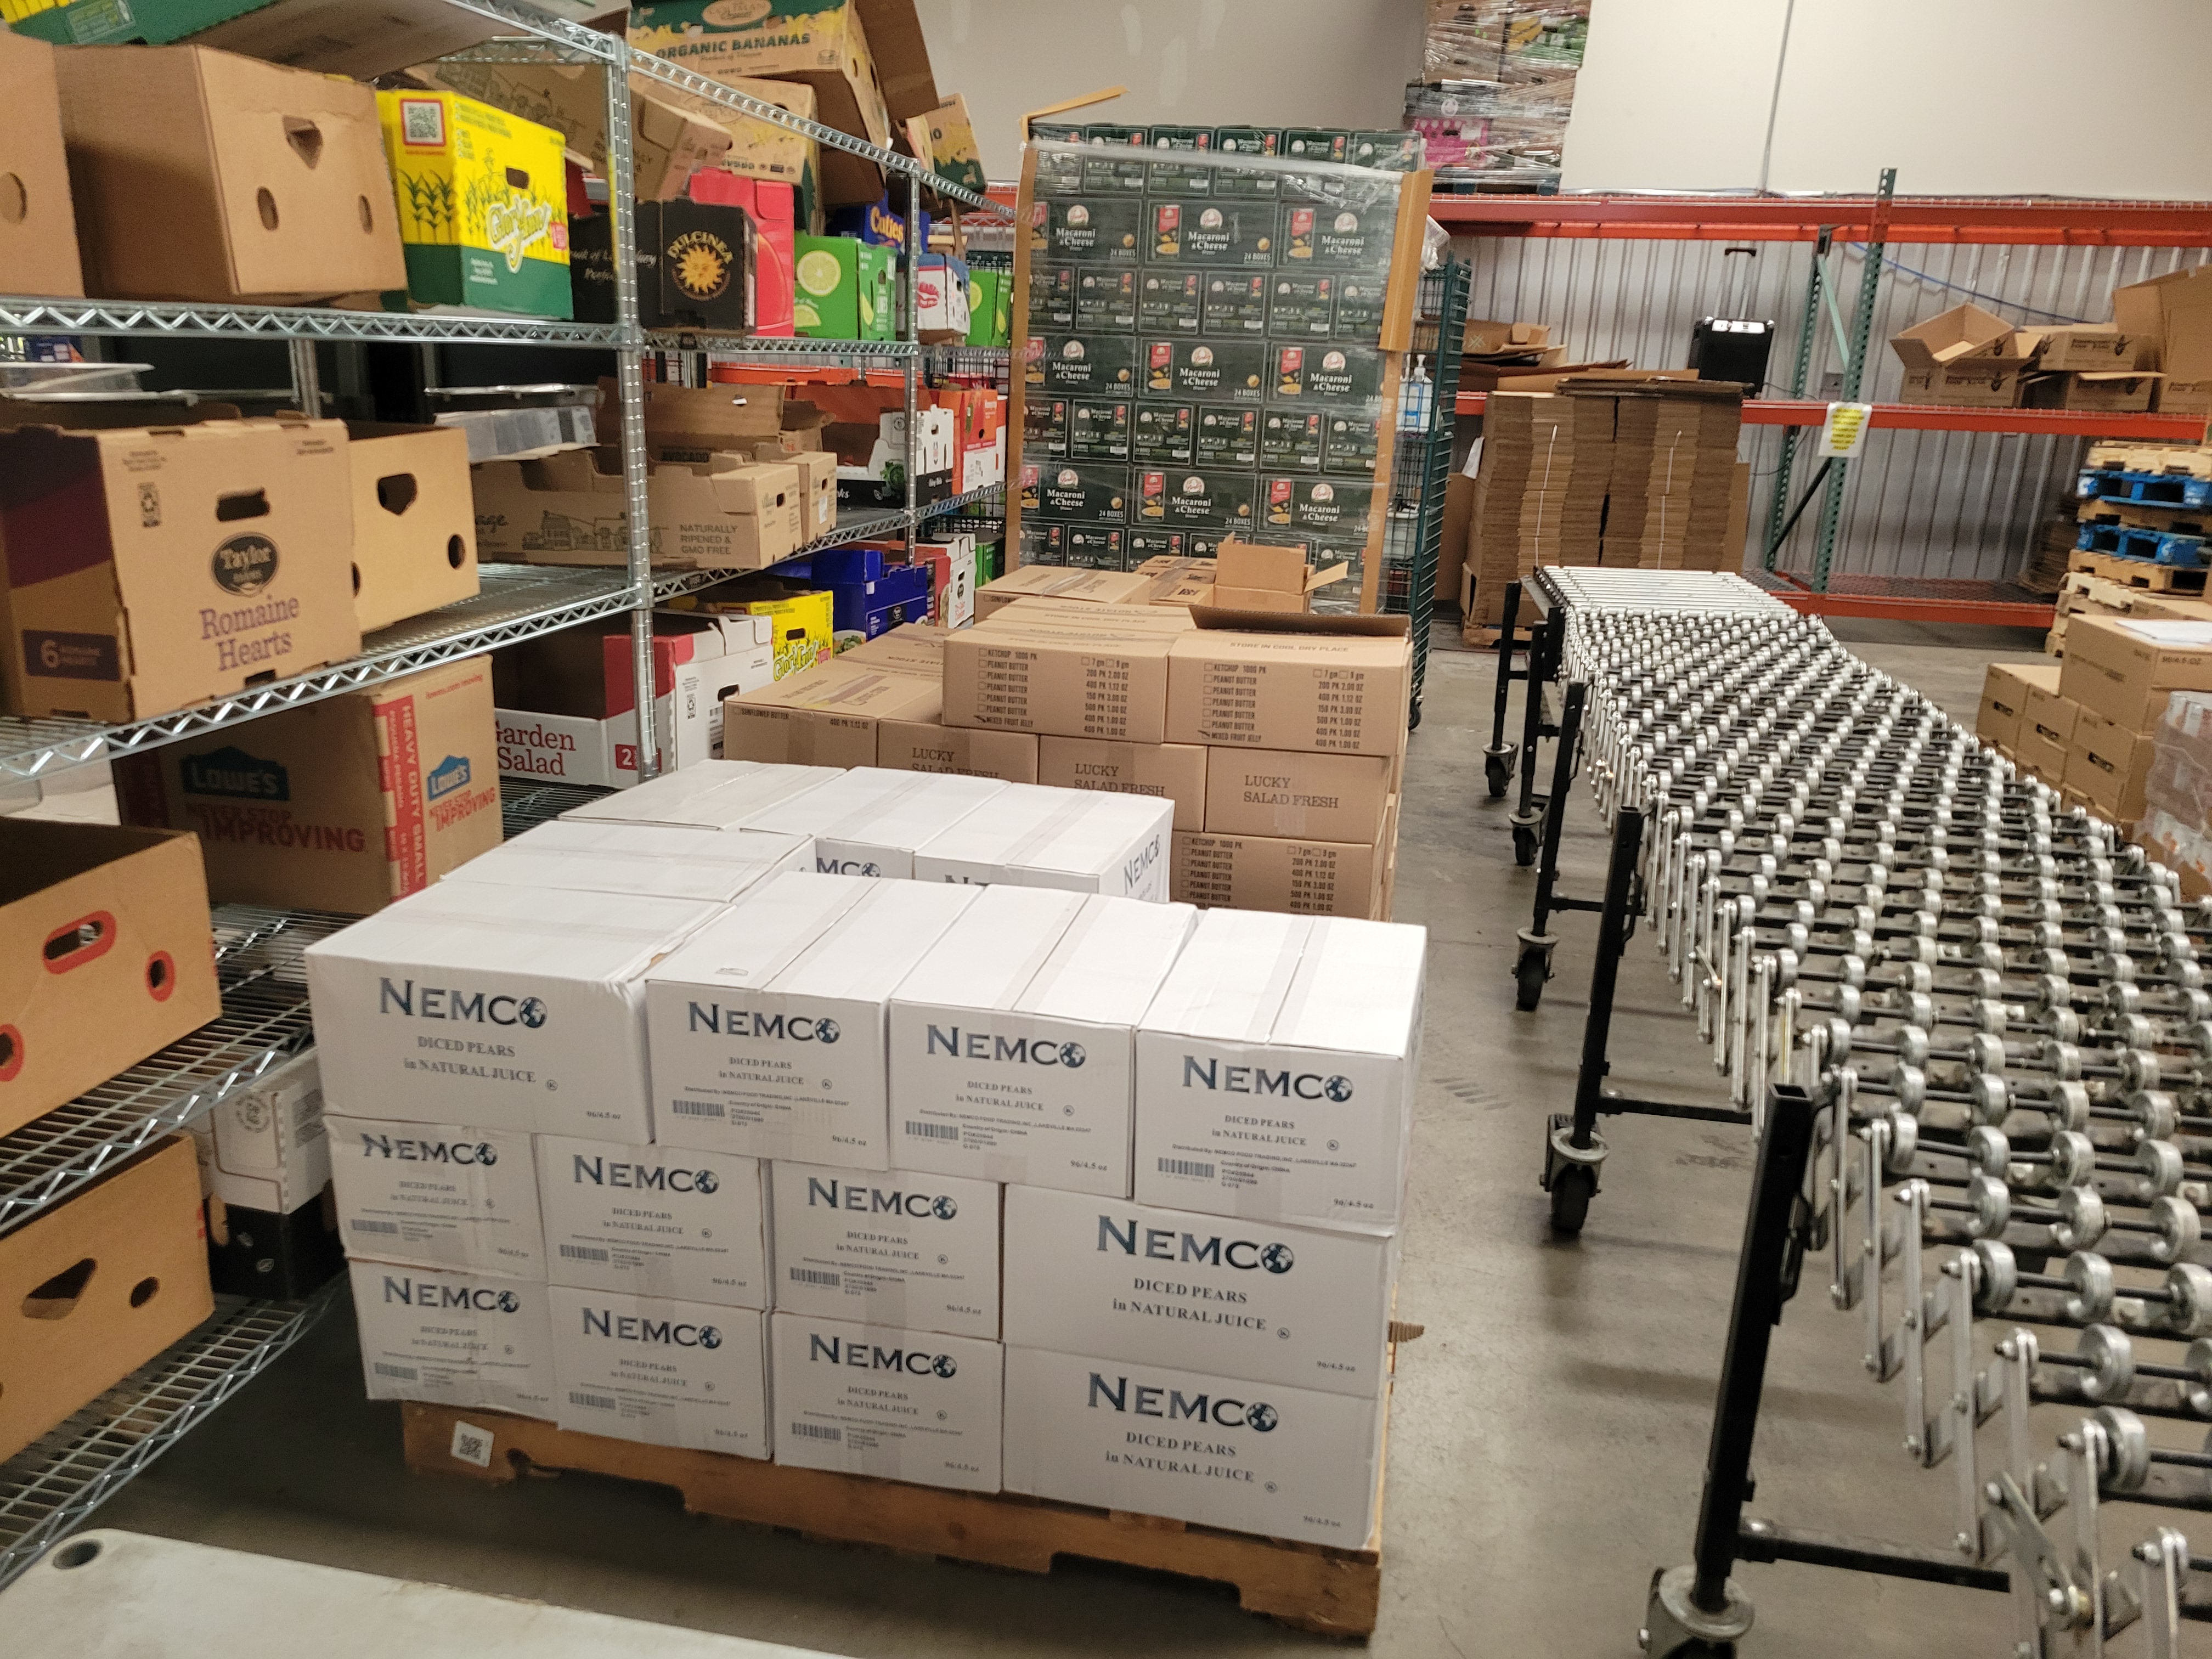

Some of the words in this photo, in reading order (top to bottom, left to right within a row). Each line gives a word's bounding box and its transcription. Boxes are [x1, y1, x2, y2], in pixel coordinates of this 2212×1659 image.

[656, 41, 727, 59] ORGANIC
[732, 33, 811, 50] BANANAS
[870, 206, 904, 243] Cuties
[1056, 228, 1096, 238] Macaroni
[1188, 232, 1229, 241] Macaroni
[1322, 235, 1364, 246] Macaroni
[668, 231, 733, 264] DULCINEA
[1052, 362, 1091, 371] Macaroni
[1180, 368, 1220, 377] Macaroni
[1310, 373, 1352, 384] Macaroni
[1047, 489, 1085, 499] Macaroni
[1172, 496, 1211, 506] Macaroni
[1300, 504, 1340, 514] Macaroni
[680, 524, 738, 533] NATURALLY
[680, 535, 721, 544] RIPENED
[219, 545, 272, 570] Taylor
[682, 546, 707, 554] GMO
[707, 546, 731, 554] FREE
[199, 594, 300, 640] Romaine
[40, 639, 59, 668] 6
[216, 631, 292, 672] Hearts
[1214, 664, 1238, 673] KETCHUP
[1214, 675, 1234, 684] PEANUT
[1236, 676, 1256, 685] BUTTER
[1214, 686, 1234, 696] PEANUT
[1235, 689, 1256, 697] BUTTER
[1213, 698, 1233, 707] PEANUT
[1235, 700, 1255, 708] BUTTER
[742, 708, 769, 718] SUNFLOWER
[771, 712, 789, 720] BUTTER
[1212, 710, 1233, 718] PEANUT
[1235, 712, 1255, 720] BUTTER
[1212, 721, 1232, 730] PEANUT
[1234, 723, 1254, 731] BUTTER
[403, 706, 417, 765] HEAVY
[1212, 732, 1228, 741] MIXED
[1230, 733, 1245, 742] FRUIT
[1247, 735, 1261, 743] JELLY
[498, 746, 566, 776] Salad
[622, 748, 632, 765] 2
[912, 748, 954, 762] LUCKY
[1075, 764, 1119, 777] LUCKY
[1074, 780, 1118, 792] SALAD
[1121, 783, 1165, 797] FRESH
[1245, 775, 1290, 788] LUCKY
[408, 771, 421, 817] DUTY
[1244, 792, 1289, 805] SALAD
[1292, 794, 1338, 809] FRESH
[436, 787, 496, 832] IMPROVING
[201, 820, 365, 852] IMPROVING
[413, 823, 425, 883] SMALL
[379, 977, 548, 1028] NEMCO
[689, 1001, 840, 1043] NEMCO
[418, 1036, 464, 1052] DICED
[468, 1042, 516, 1057] PEARS
[927, 1024, 1086, 1068] NEMCO
[405, 1059, 416, 1070] in
[420, 1060, 492, 1078] NATURAL
[493, 1068, 537, 1082] JUICE
[730, 1057, 759, 1067] DICED
[761, 1060, 792, 1069] PEARS
[720, 1070, 727, 1079] in
[730, 1072, 774, 1082] NATURAL
[776, 1076, 804, 1085] JUICE
[1182, 1055, 1353, 1103] NEMCO
[967, 1080, 998, 1091] DICED
[1000, 1085, 1032, 1094] PEARS
[966, 1096, 1013, 1108] NATURAL
[1015, 1101, 1044, 1111] JUICE
[1224, 1115, 1258, 1126] DICED
[1261, 1119, 1295, 1129] PEARS
[1211, 1128, 1220, 1137] in
[1223, 1130, 1272, 1142] NATURAL
[1274, 1136, 1306, 1146] JUICE
[361, 1133, 498, 1166] NEMCO
[573, 1154, 719, 1194] NEMCO
[808, 1176, 958, 1220] NEMCO
[612, 1207, 641, 1218] DICED
[644, 1210, 673, 1220] PEARS
[612, 1221, 655, 1232] NATURAL
[657, 1226, 684, 1235] JUICE
[847, 1231, 876, 1241] DICED
[878, 1234, 908, 1245] PEARS
[1097, 1215, 1294, 1274] NEMCO
[846, 1244, 890, 1256] NATURAL
[892, 1250, 919, 1260] JUICE
[384, 1276, 520, 1313] NEMCO
[1133, 1277, 1188, 1296] DICED
[1192, 1286, 1248, 1303] PEARS
[1113, 1298, 1126, 1311] in
[1130, 1302, 1212, 1323] NATURAL
[1215, 1313, 1267, 1330] JUICE
[583, 1307, 723, 1349] NEMCO
[810, 1333, 957, 1378] NEMCO
[848, 1386, 877, 1396] DICED
[879, 1390, 909, 1400] PEARS
[838, 1397, 845, 1406] in
[847, 1399, 890, 1411] NATURAL
[891, 1405, 919, 1415] JUICE
[1088, 1372, 1278, 1432] NEMCO
[1126, 1431, 1178, 1449] DICED
[1182, 1440, 1236, 1457] PEARS
[1105, 1451, 1119, 1463] in
[1123, 1453, 1201, 1474] NATURAL
[1205, 1464, 1255, 1482] JUICE
